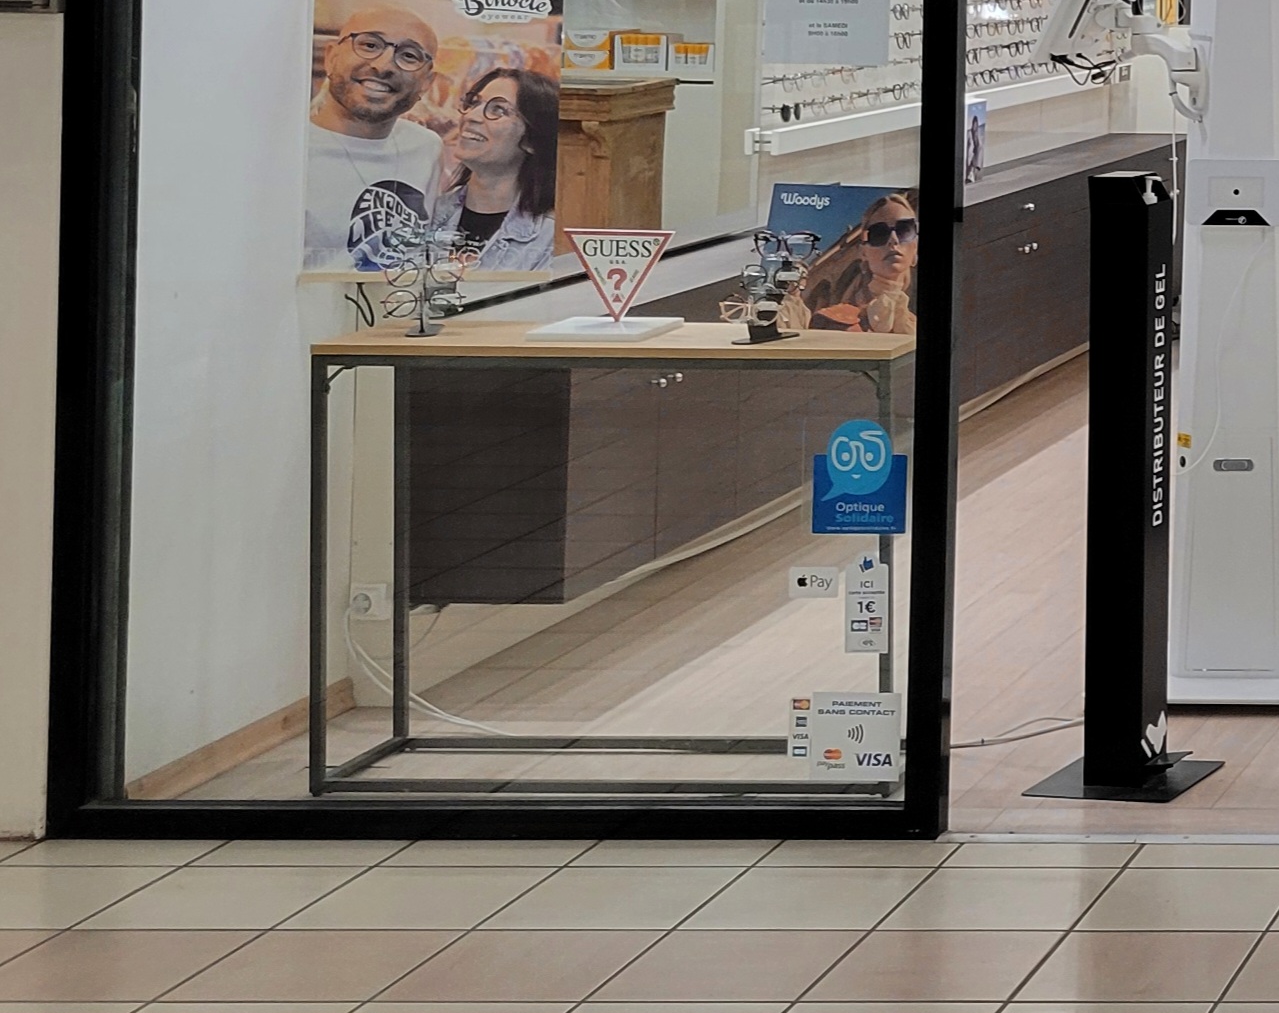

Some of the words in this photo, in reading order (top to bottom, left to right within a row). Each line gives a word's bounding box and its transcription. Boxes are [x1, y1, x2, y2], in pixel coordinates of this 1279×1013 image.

[780, 193, 831, 210] Woodys
[582, 238, 653, 258] GUESS
[1155, 263, 1166, 311] GEL
[1154, 316, 1166, 348] DE
[1151, 353, 1166, 527] DISTRIBUTEUR
[835, 502, 885, 514] Optique
[835, 513, 894, 523] Solidaire
[810, 575, 833, 590] Pay
[857, 601, 876, 613] 1€
[855, 753, 893, 767] VISA
